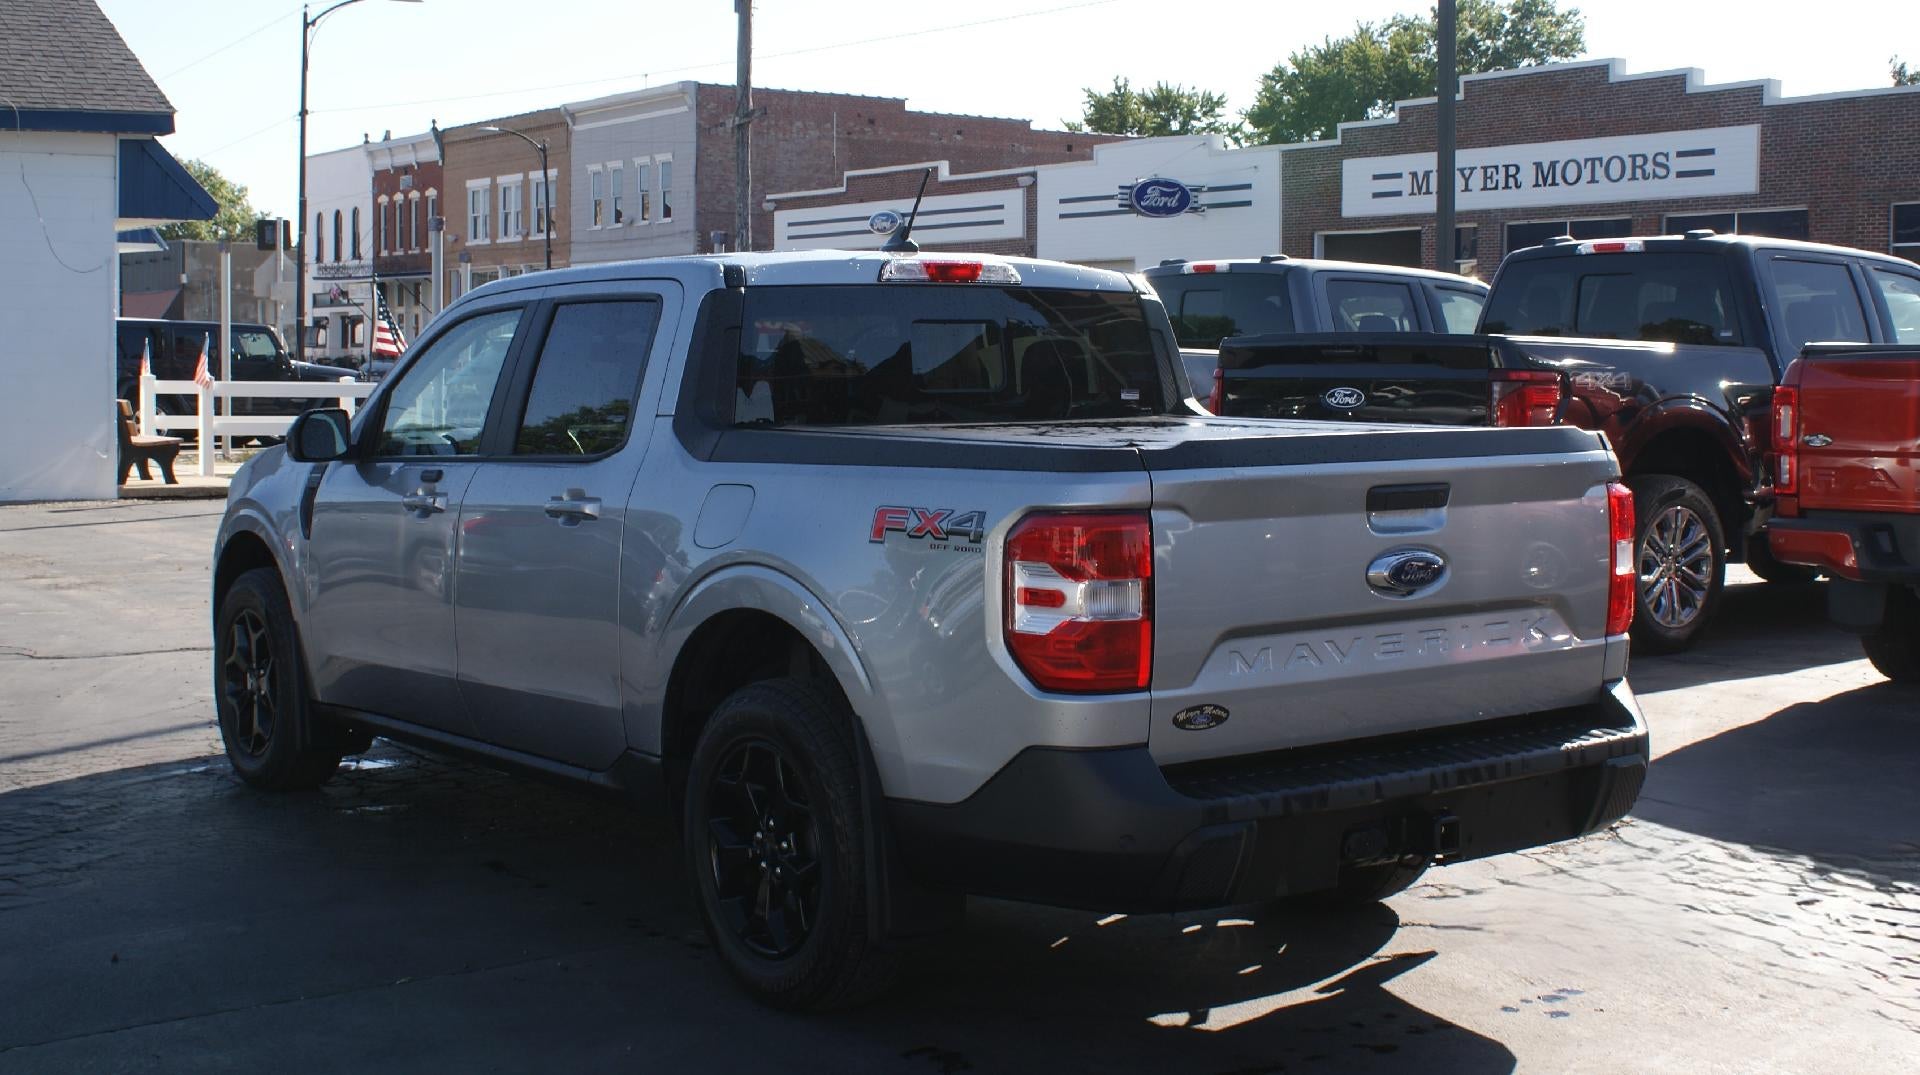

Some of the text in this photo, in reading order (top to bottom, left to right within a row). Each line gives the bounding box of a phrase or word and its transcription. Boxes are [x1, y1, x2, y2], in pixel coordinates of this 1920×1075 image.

[1408, 152, 1671, 196] MYER MOTORS
[1141, 185, 1181, 208] Ford
[1329, 389, 1358, 404] Ford
[868, 505, 987, 544] FX4
[929, 543, 982, 553] OFF ROAD
[1401, 561, 1433, 579] Ford
[1229, 616, 1549, 676] MAVERICK
